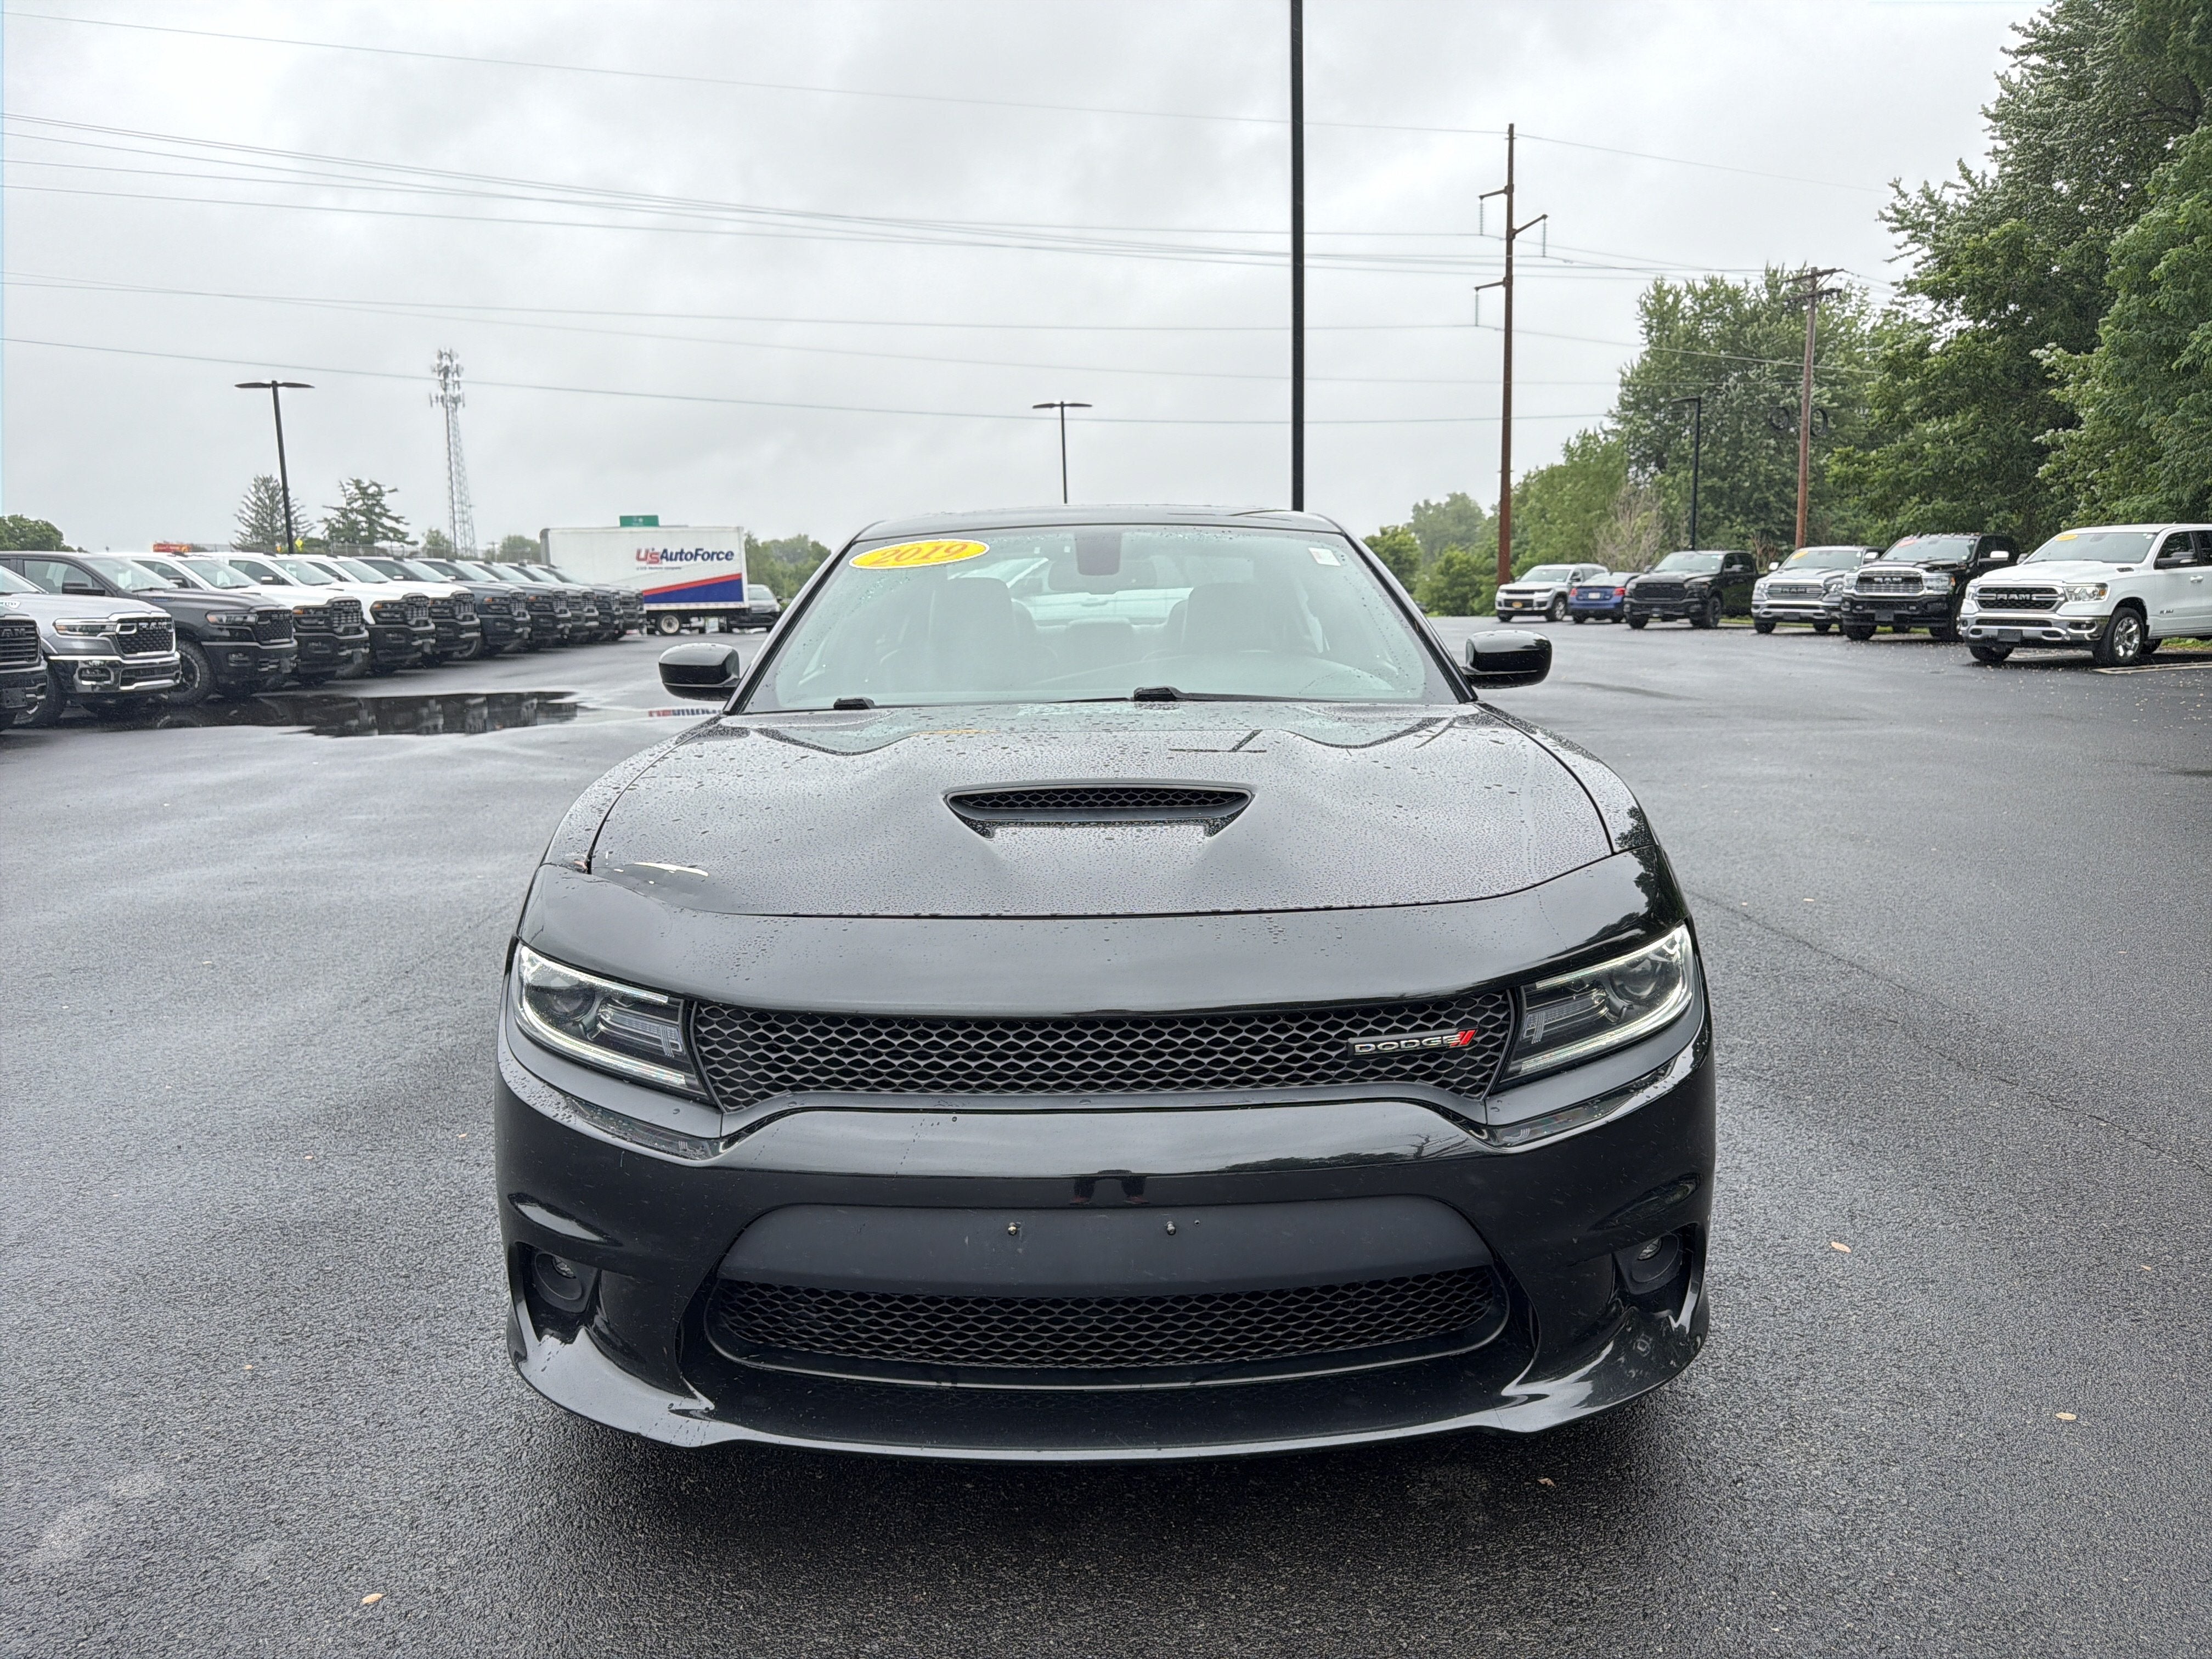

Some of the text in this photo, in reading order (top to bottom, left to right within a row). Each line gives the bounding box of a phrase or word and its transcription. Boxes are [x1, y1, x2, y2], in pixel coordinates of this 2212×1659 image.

[869, 543, 968, 566] 2019
[0, 628, 26, 637] AM
[1355, 1034, 1462, 1053] DODGE
